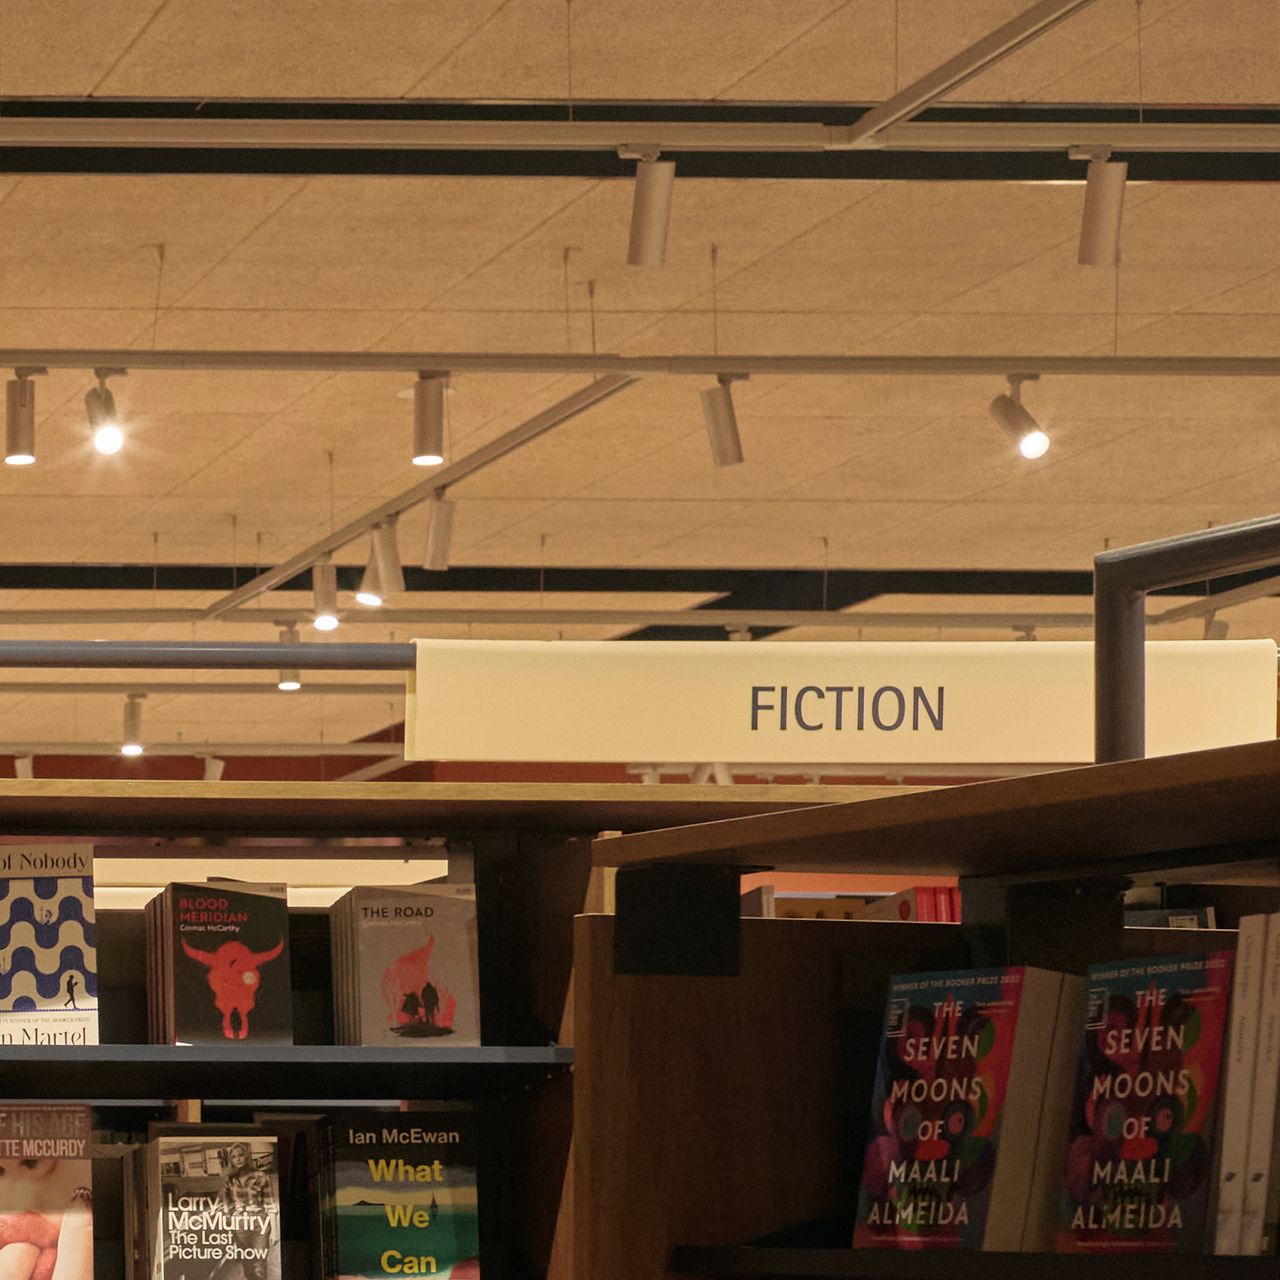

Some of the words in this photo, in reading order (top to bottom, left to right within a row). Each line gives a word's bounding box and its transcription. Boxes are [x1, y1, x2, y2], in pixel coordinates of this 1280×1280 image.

[749, 685, 945, 731] FICTION
[19, 852, 90, 873] Nobody
[179, 898, 229, 911] BLOOD
[361, 906, 389, 918] THE
[393, 906, 434, 918] ROAD
[179, 911, 249, 923] MERIDIAN
[933, 1000, 965, 1018] THE
[1135, 988, 1168, 1008] THE
[22, 1027, 88, 1046] Martel
[903, 1034, 981, 1061] SEVEN
[1104, 1025, 1185, 1056] SEVEN
[890, 1076, 983, 1104] MOONS
[1092, 1069, 1190, 1100] MOONS
[348, 1128, 377, 1145] Ian
[381, 1128, 461, 1145] McEwan
[917, 1119, 945, 1141] OF
[1122, 1116, 1152, 1140] OF
[22, 1139, 86, 1157] MCCURDY
[366, 1158, 444, 1183] What
[887, 1158, 961, 1184] MAALI
[1092, 1157, 1171, 1185] MAALI
[167, 1192, 220, 1216] Larry
[384, 1202, 431, 1229] We
[867, 1200, 970, 1227] ALMEIDA
[1071, 1202, 1184, 1230] ALMEIDA
[167, 1211, 271, 1235] McMurtry
[169, 1230, 199, 1245] The
[201, 1230, 234, 1245] Last
[169, 1244, 223, 1260] Picture
[225, 1244, 269, 1260] Show
[380, 1249, 438, 1275] Can
